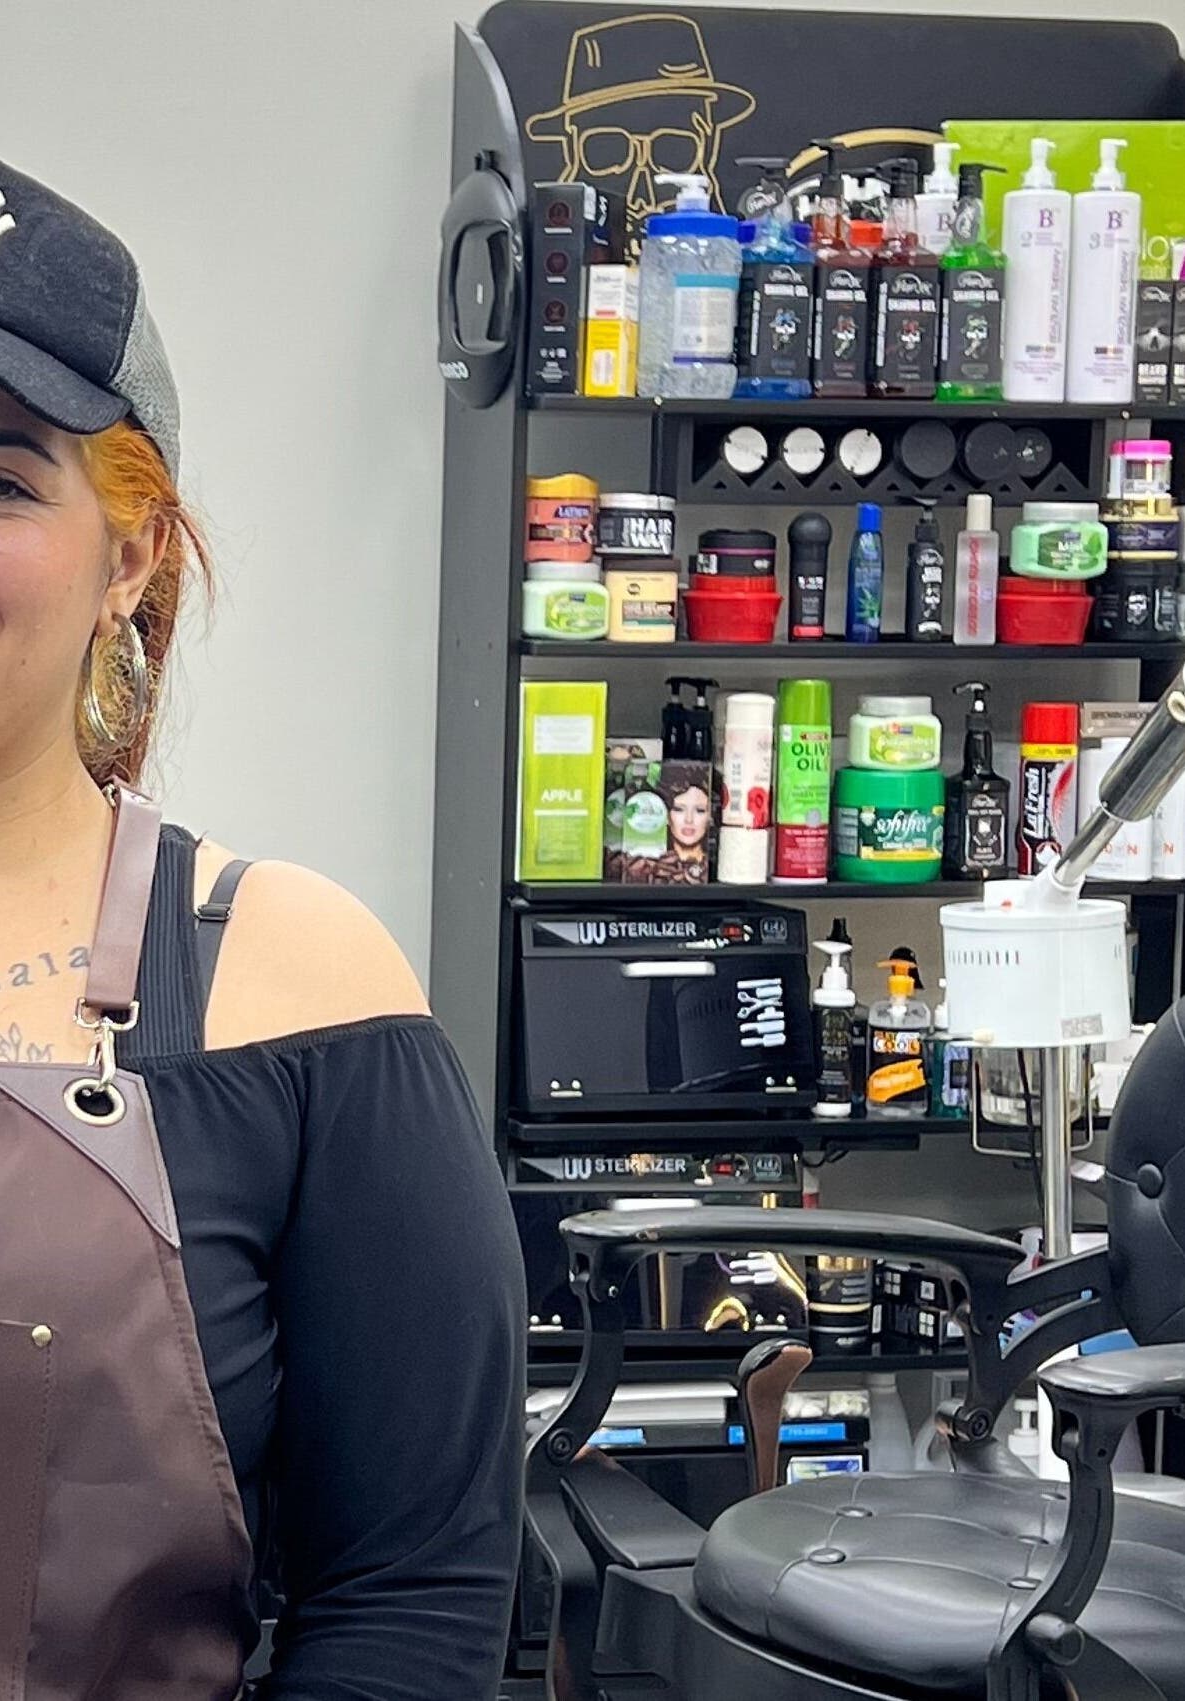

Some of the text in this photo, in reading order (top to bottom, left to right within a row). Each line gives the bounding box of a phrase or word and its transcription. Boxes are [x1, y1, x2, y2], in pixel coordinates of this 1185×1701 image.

[630, 518, 673, 536] HAIR
[791, 742, 831, 757] OLIV
[797, 758, 823, 772] OIL
[541, 789, 584, 803] APPLE
[608, 922, 697, 938] STERILIZER
